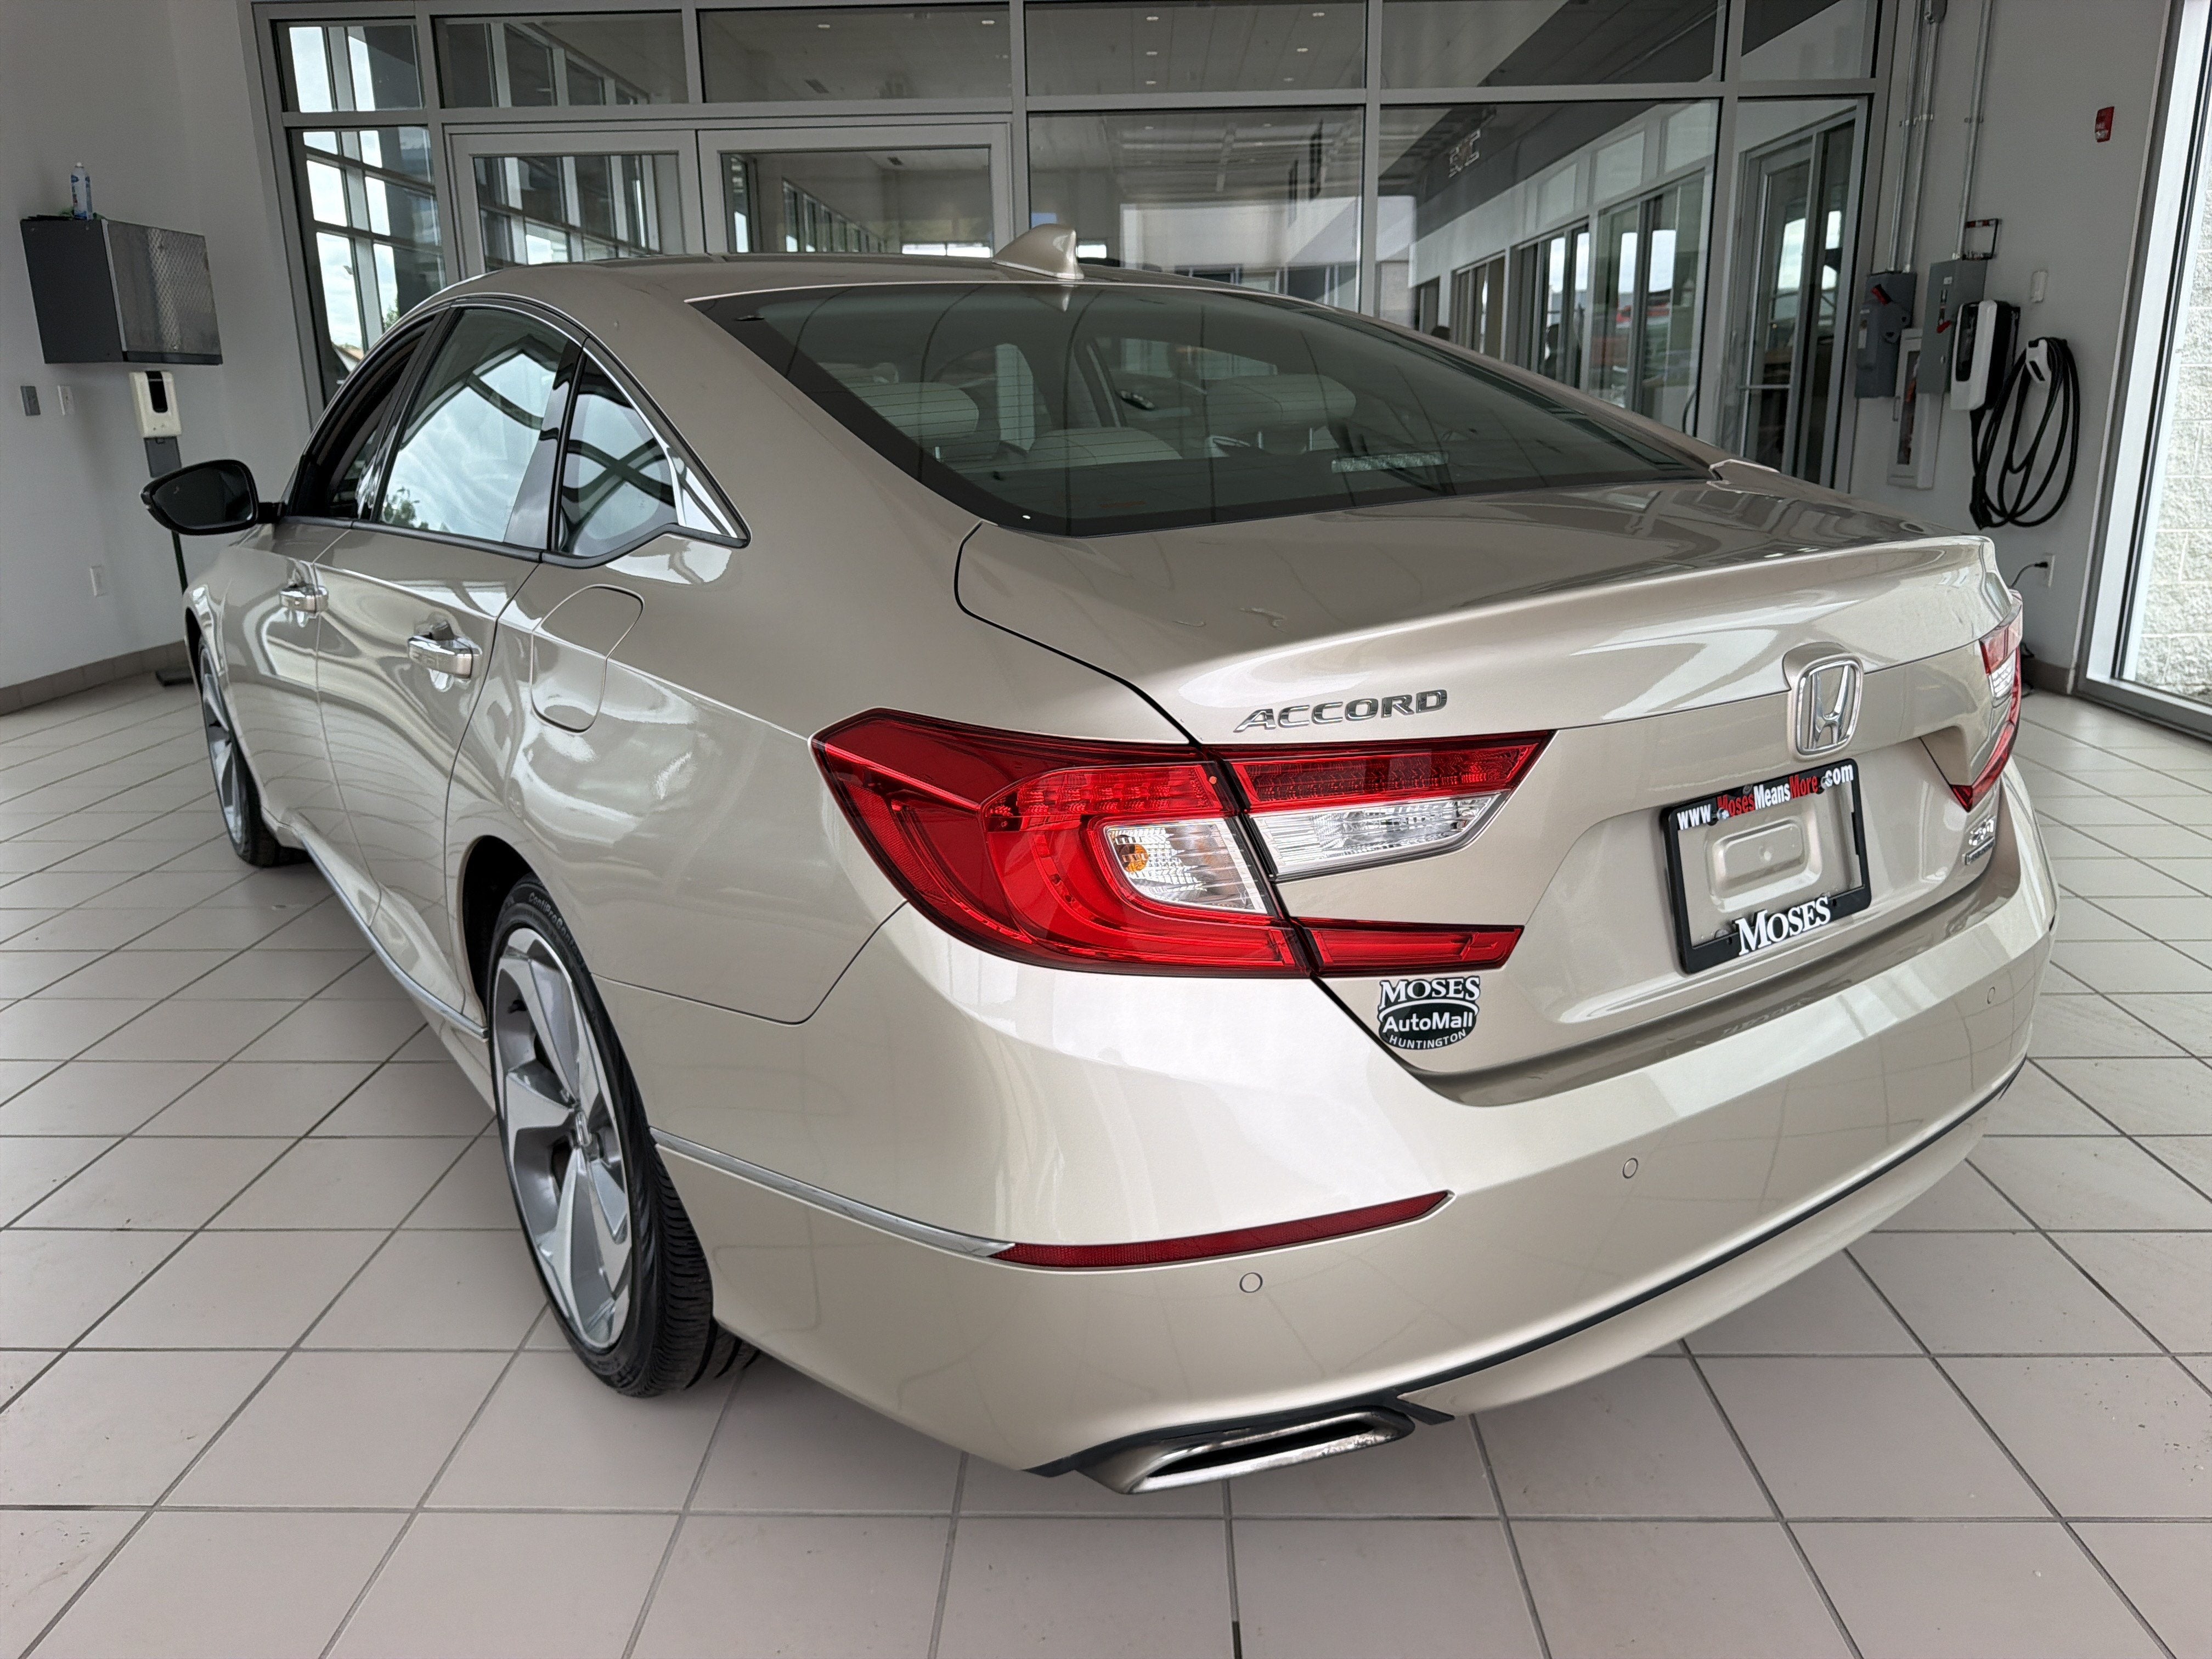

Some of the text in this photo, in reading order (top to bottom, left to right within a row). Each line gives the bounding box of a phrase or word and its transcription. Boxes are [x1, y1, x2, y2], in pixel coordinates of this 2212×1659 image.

[1233, 689, 1448, 733] ACCORD
[1677, 764, 1854, 831] wwwMosesMeansMorecom
[1735, 895, 1831, 956] MOSES
[1379, 975, 1480, 1010] MOSES
[1383, 1012, 1473, 1034] AutoMall
[1389, 1028, 1466, 1049] HUNTINGTON
